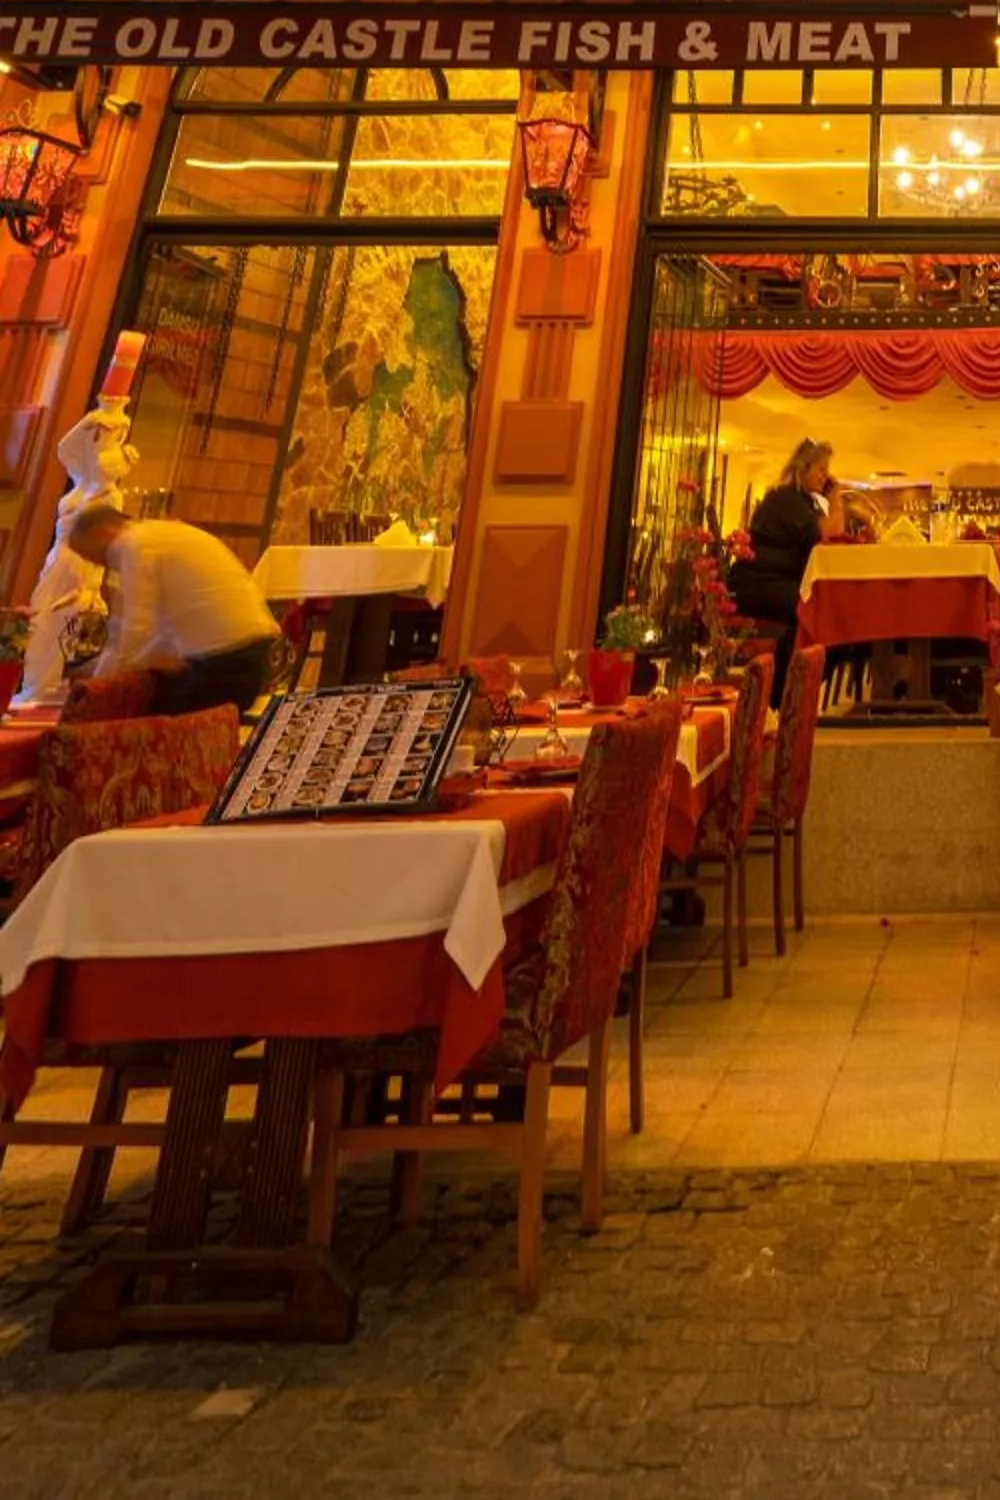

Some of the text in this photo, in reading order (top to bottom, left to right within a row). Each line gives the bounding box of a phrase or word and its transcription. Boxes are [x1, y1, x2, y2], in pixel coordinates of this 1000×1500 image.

[115, 18, 234, 58] OLD
[259, 19, 493, 60] CASTLE
[518, 21, 656, 61] FISH
[678, 21, 718, 61] &
[746, 21, 911, 61] MEAT
